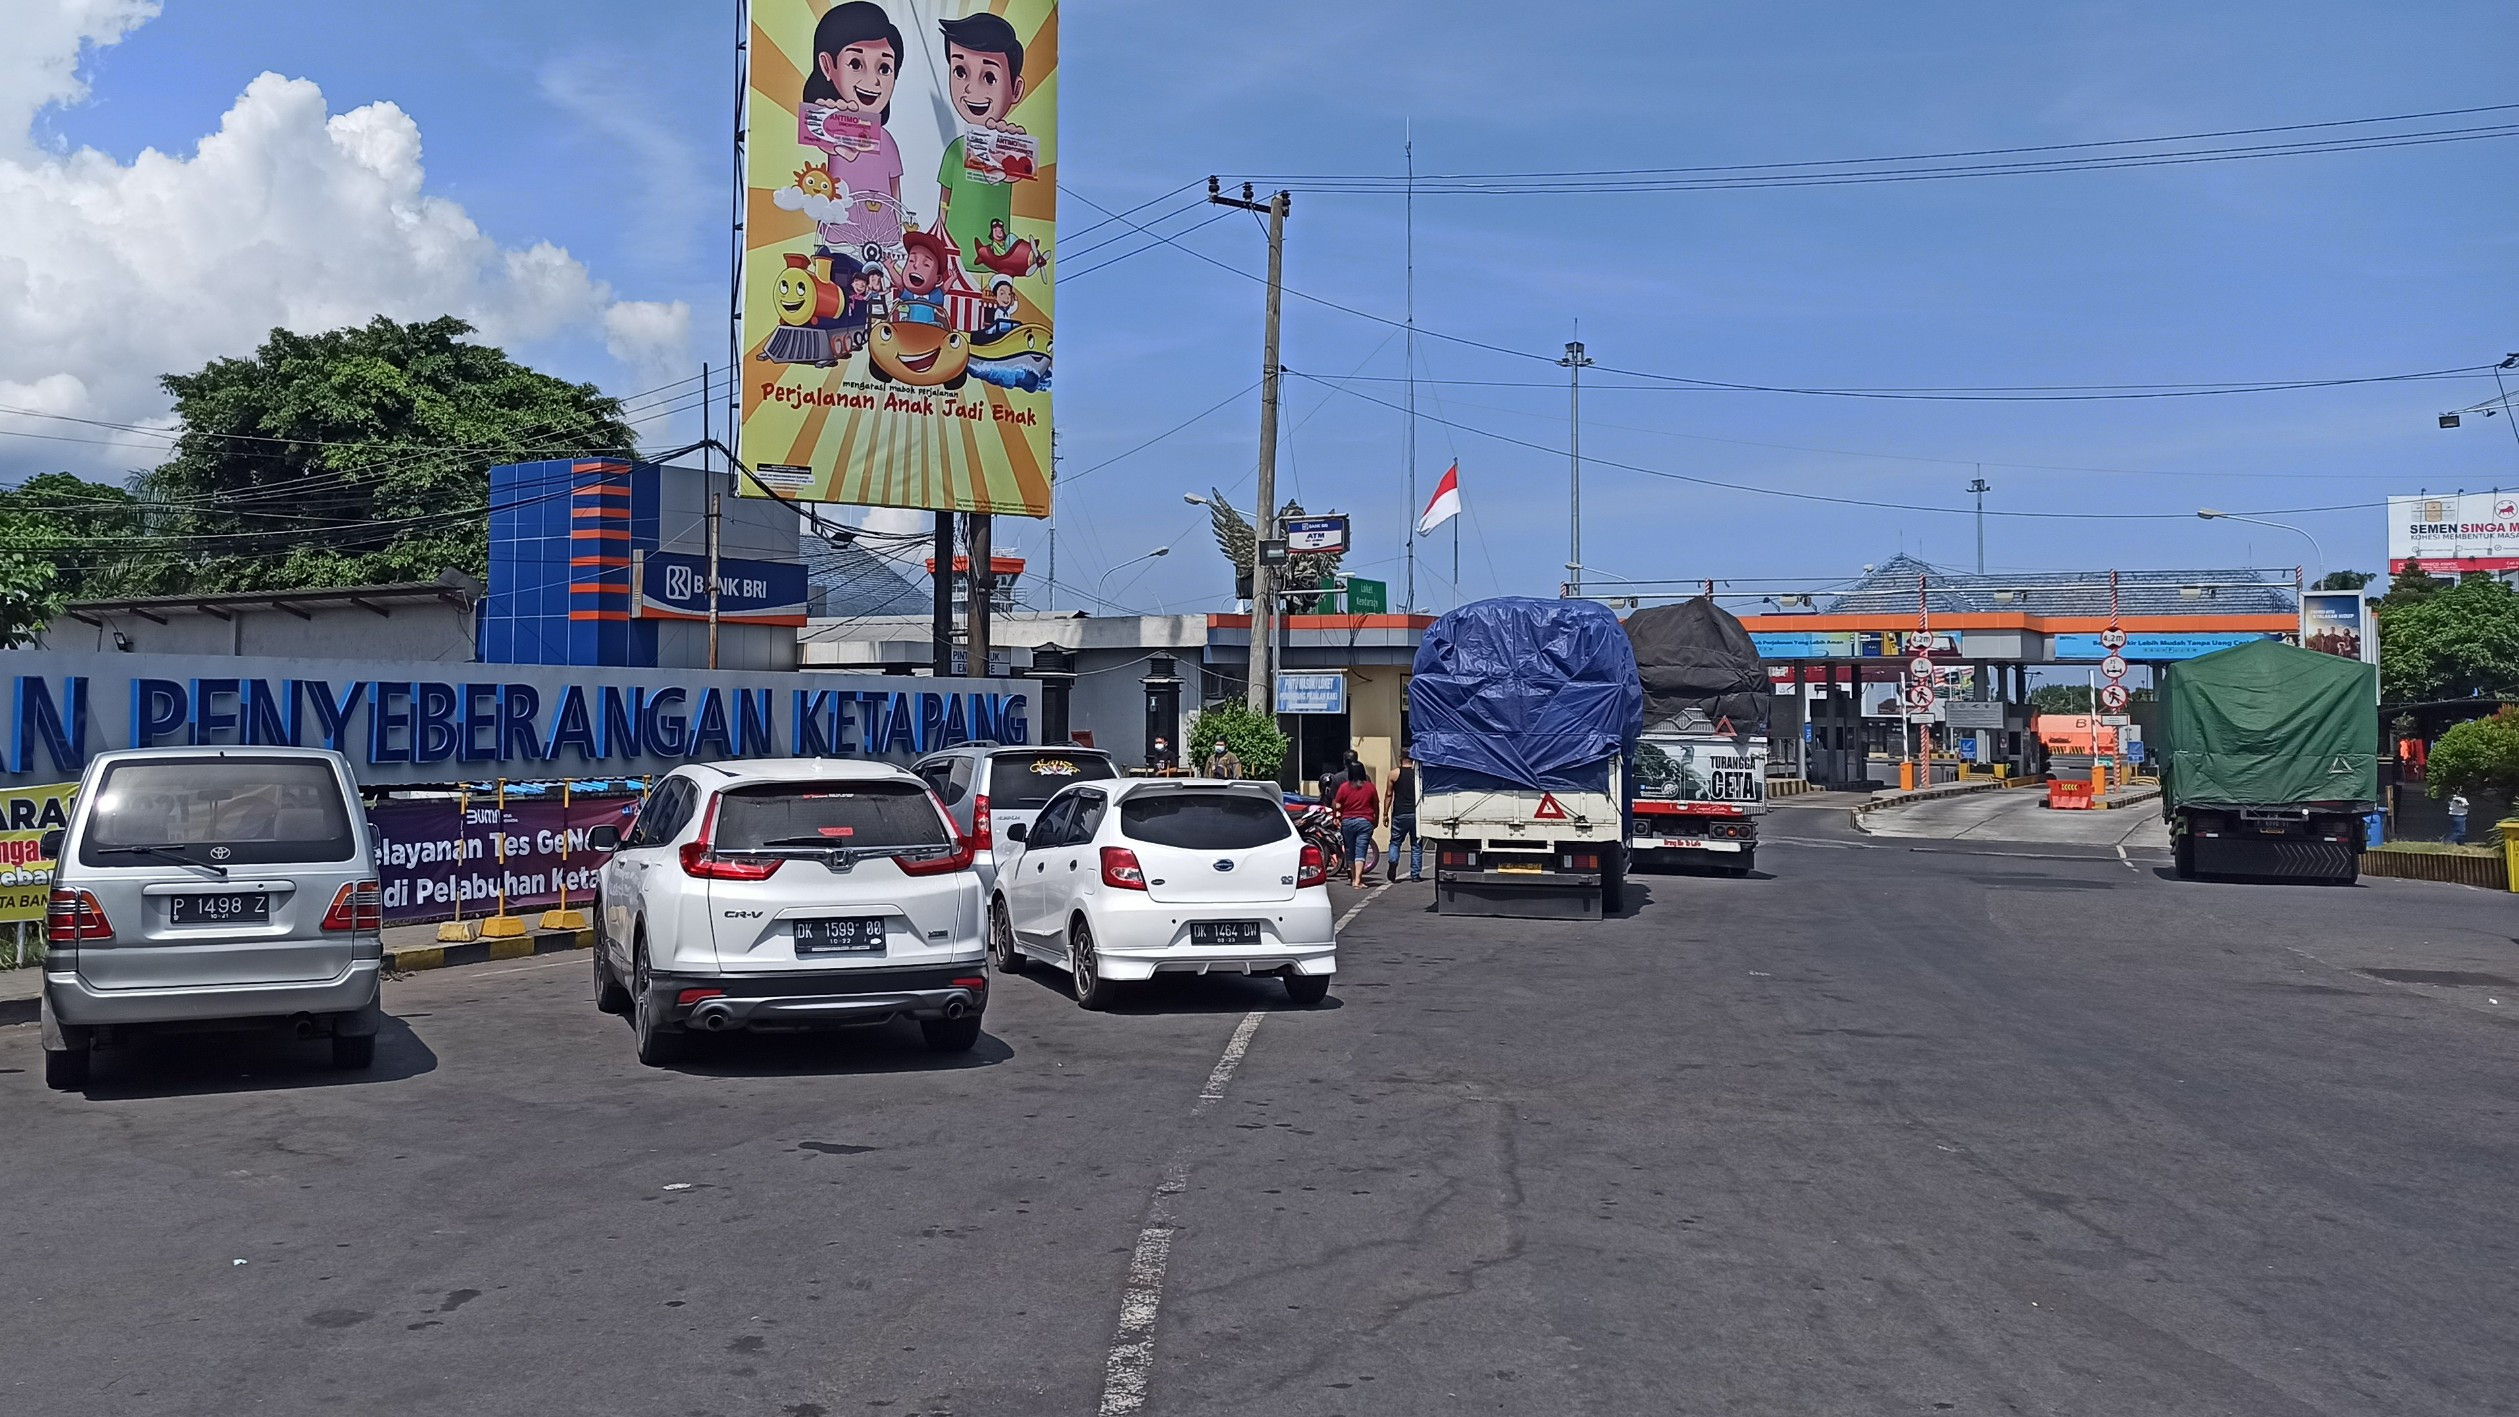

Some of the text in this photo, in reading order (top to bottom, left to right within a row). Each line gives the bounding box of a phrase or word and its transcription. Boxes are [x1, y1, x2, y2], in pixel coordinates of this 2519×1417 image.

[889, 385, 915, 394] mabok
[918, 387, 959, 398] perjalanan
[761, 382, 1037, 426] Perjalanan Anak Jadi Enak
[2410, 524, 2458, 534] SEMEN
[2461, 522, 2506, 533] SINGA
[694, 575, 767, 598] BNK BRI
[130, 678, 773, 764] PENYEBERANGAN
[792, 690, 1027, 754] KETAPANG
[1710, 756, 1757, 770] TURANGGA
[1711, 771, 1756, 799] CETA
[375, 837, 483, 869] elayanan
[489, 832, 530, 857] Tes
[384, 879, 408, 907] di
[417, 870, 545, 905] Pelabuhan
[174, 896, 266, 915] P 1498 Z
[797, 923, 813, 939] DK
[825, 922, 855, 937] 1599
[1194, 925, 1207, 938] DK
[1214, 924, 1238, 937] 1464
